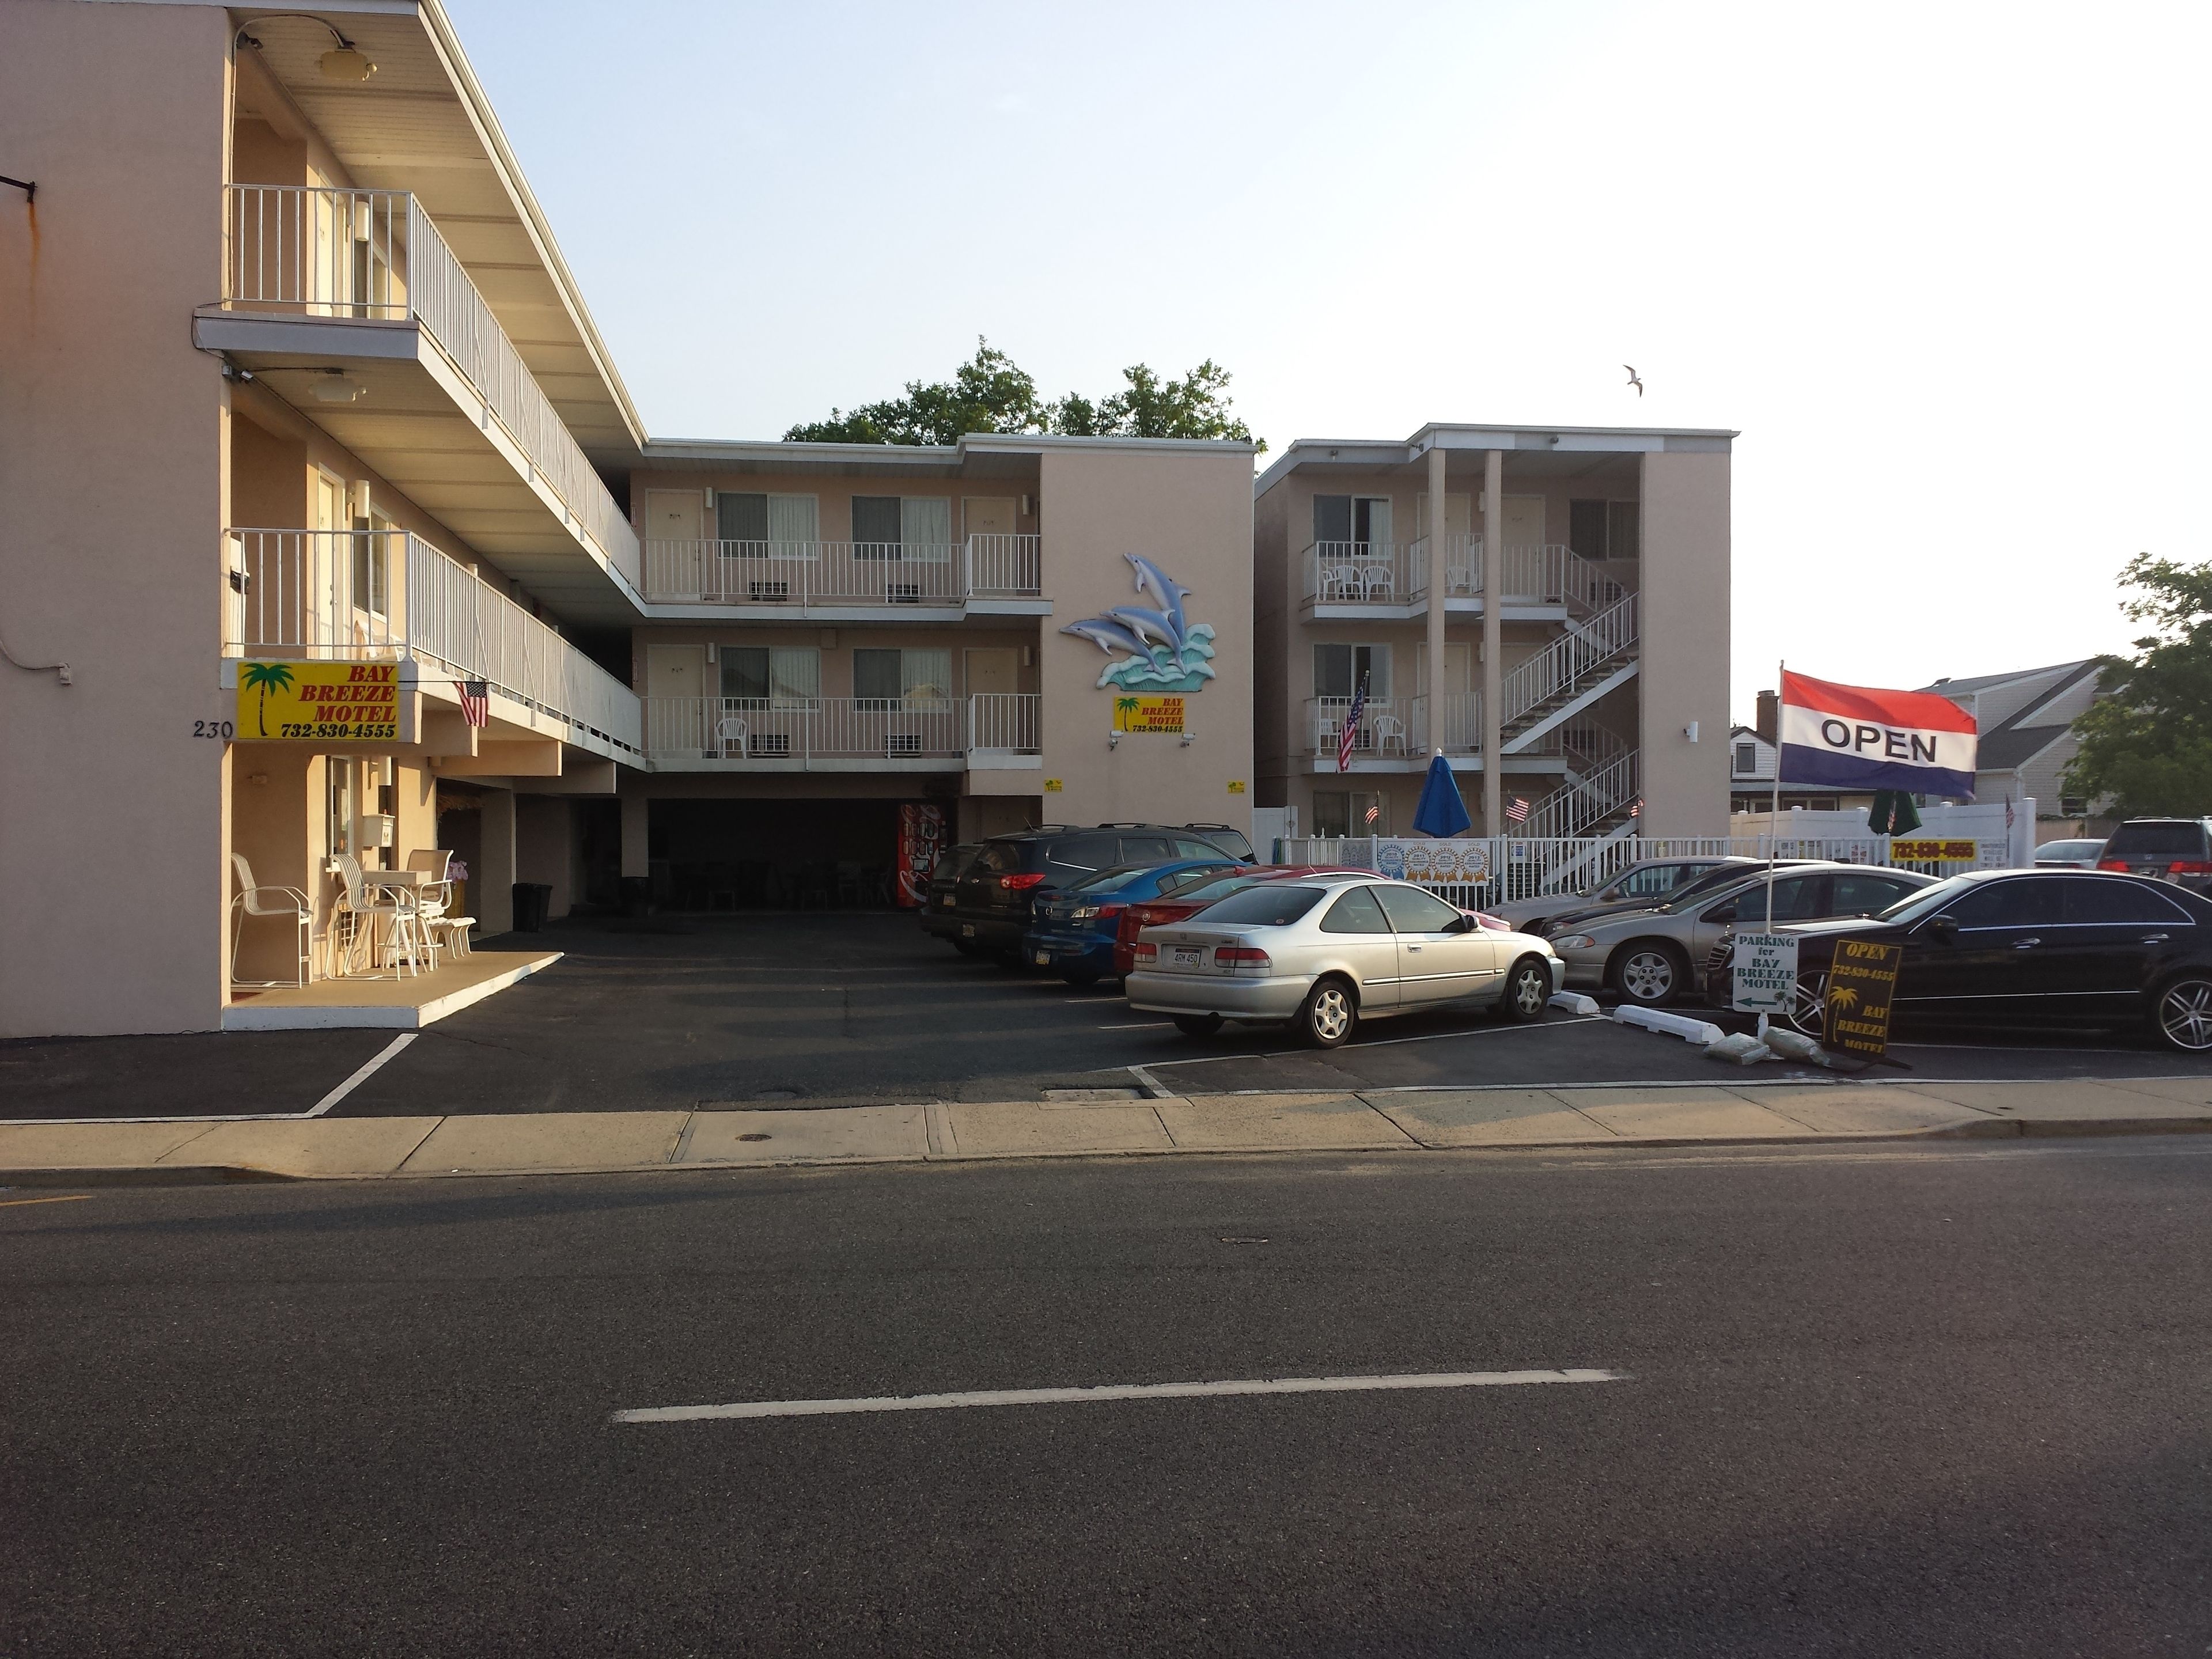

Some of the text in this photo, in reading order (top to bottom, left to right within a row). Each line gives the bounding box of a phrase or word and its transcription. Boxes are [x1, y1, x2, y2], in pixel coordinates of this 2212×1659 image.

[347, 665, 395, 682] BAY
[299, 685, 395, 702] BREEZE
[1162, 698, 1183, 706] BAY
[313, 706, 396, 722] MOTEL
[1142, 707, 1183, 715] BREEZE
[1147, 717, 1183, 725] MOTEL
[194, 721, 233, 738] 230
[281, 724, 395, 738] 732-830-4555
[1822, 719, 1937, 762] OPEN
[1739, 936, 1794, 947] PARKING
[1187, 954, 1198, 963] 450
[1758, 948, 1774, 956] for
[1846, 943, 1889, 961] OPEN
[1752, 959, 1780, 968] BAY
[1737, 968, 1794, 980] BREEZE
[1834, 965, 1895, 982] 732-830-4555
[1742, 979, 1789, 990] MOTEL
[1862, 1005, 1888, 1019] BAY
[1837, 1020, 1885, 1037] BREEZE
